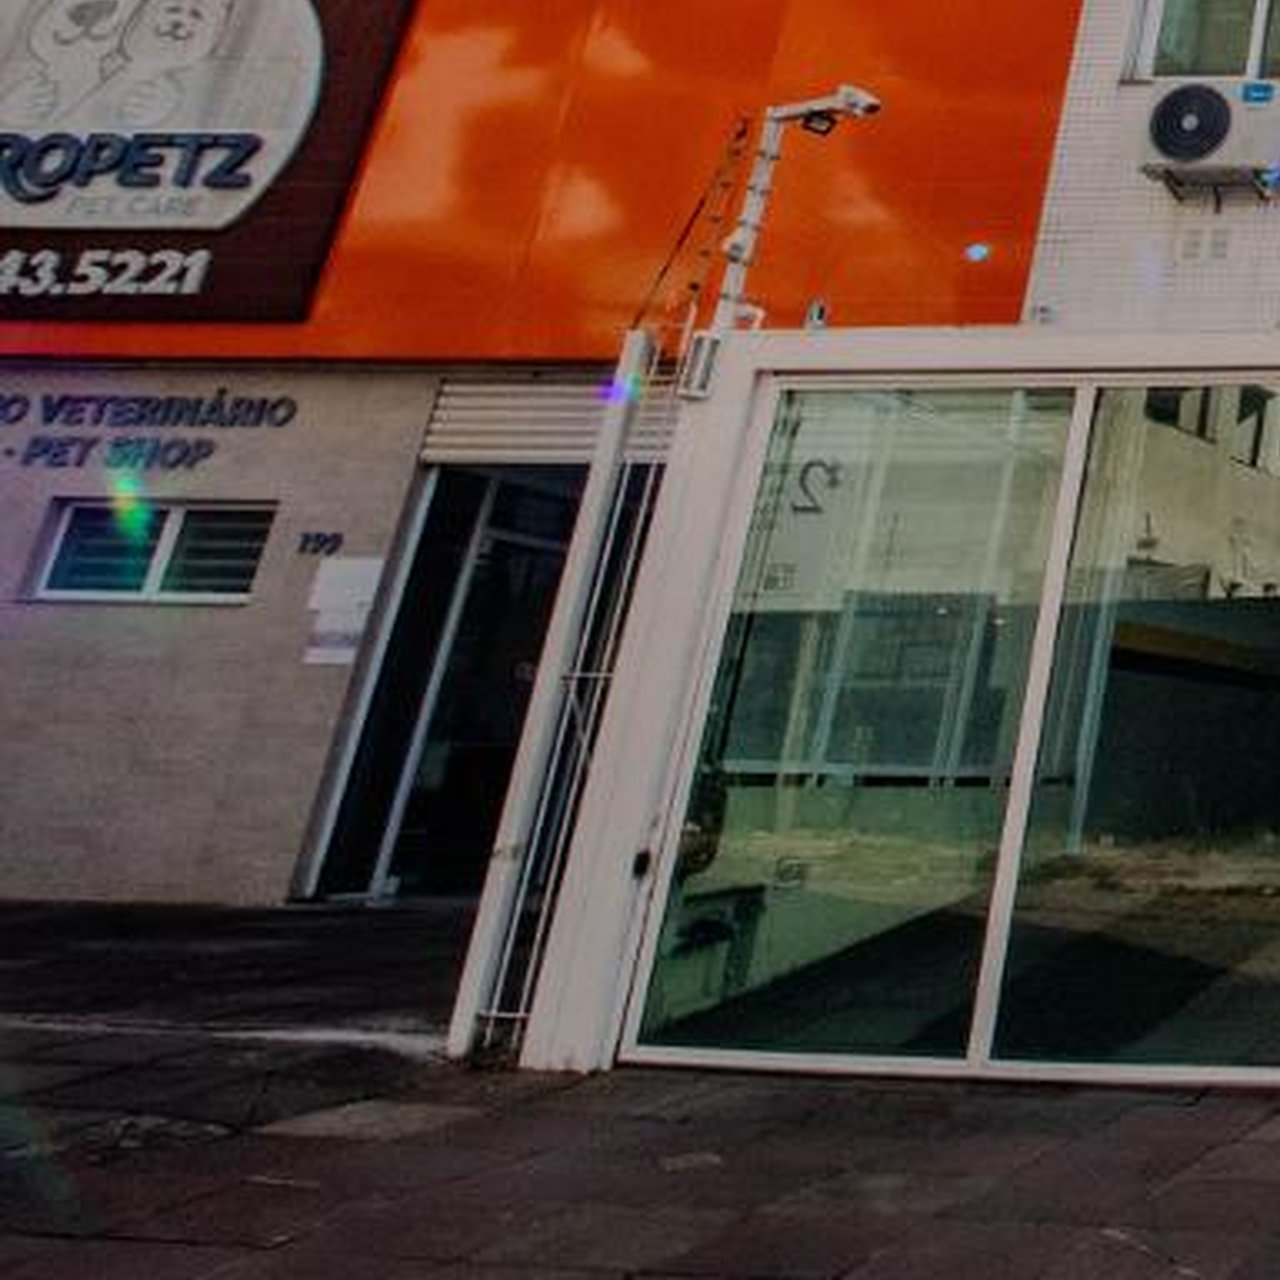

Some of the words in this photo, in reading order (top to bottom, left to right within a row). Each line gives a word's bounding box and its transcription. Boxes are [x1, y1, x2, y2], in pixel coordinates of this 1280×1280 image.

[41, 387, 298, 427] VETERINÁRIO
[21, 436, 100, 467] PET
[105, 436, 217, 469] SHOP
